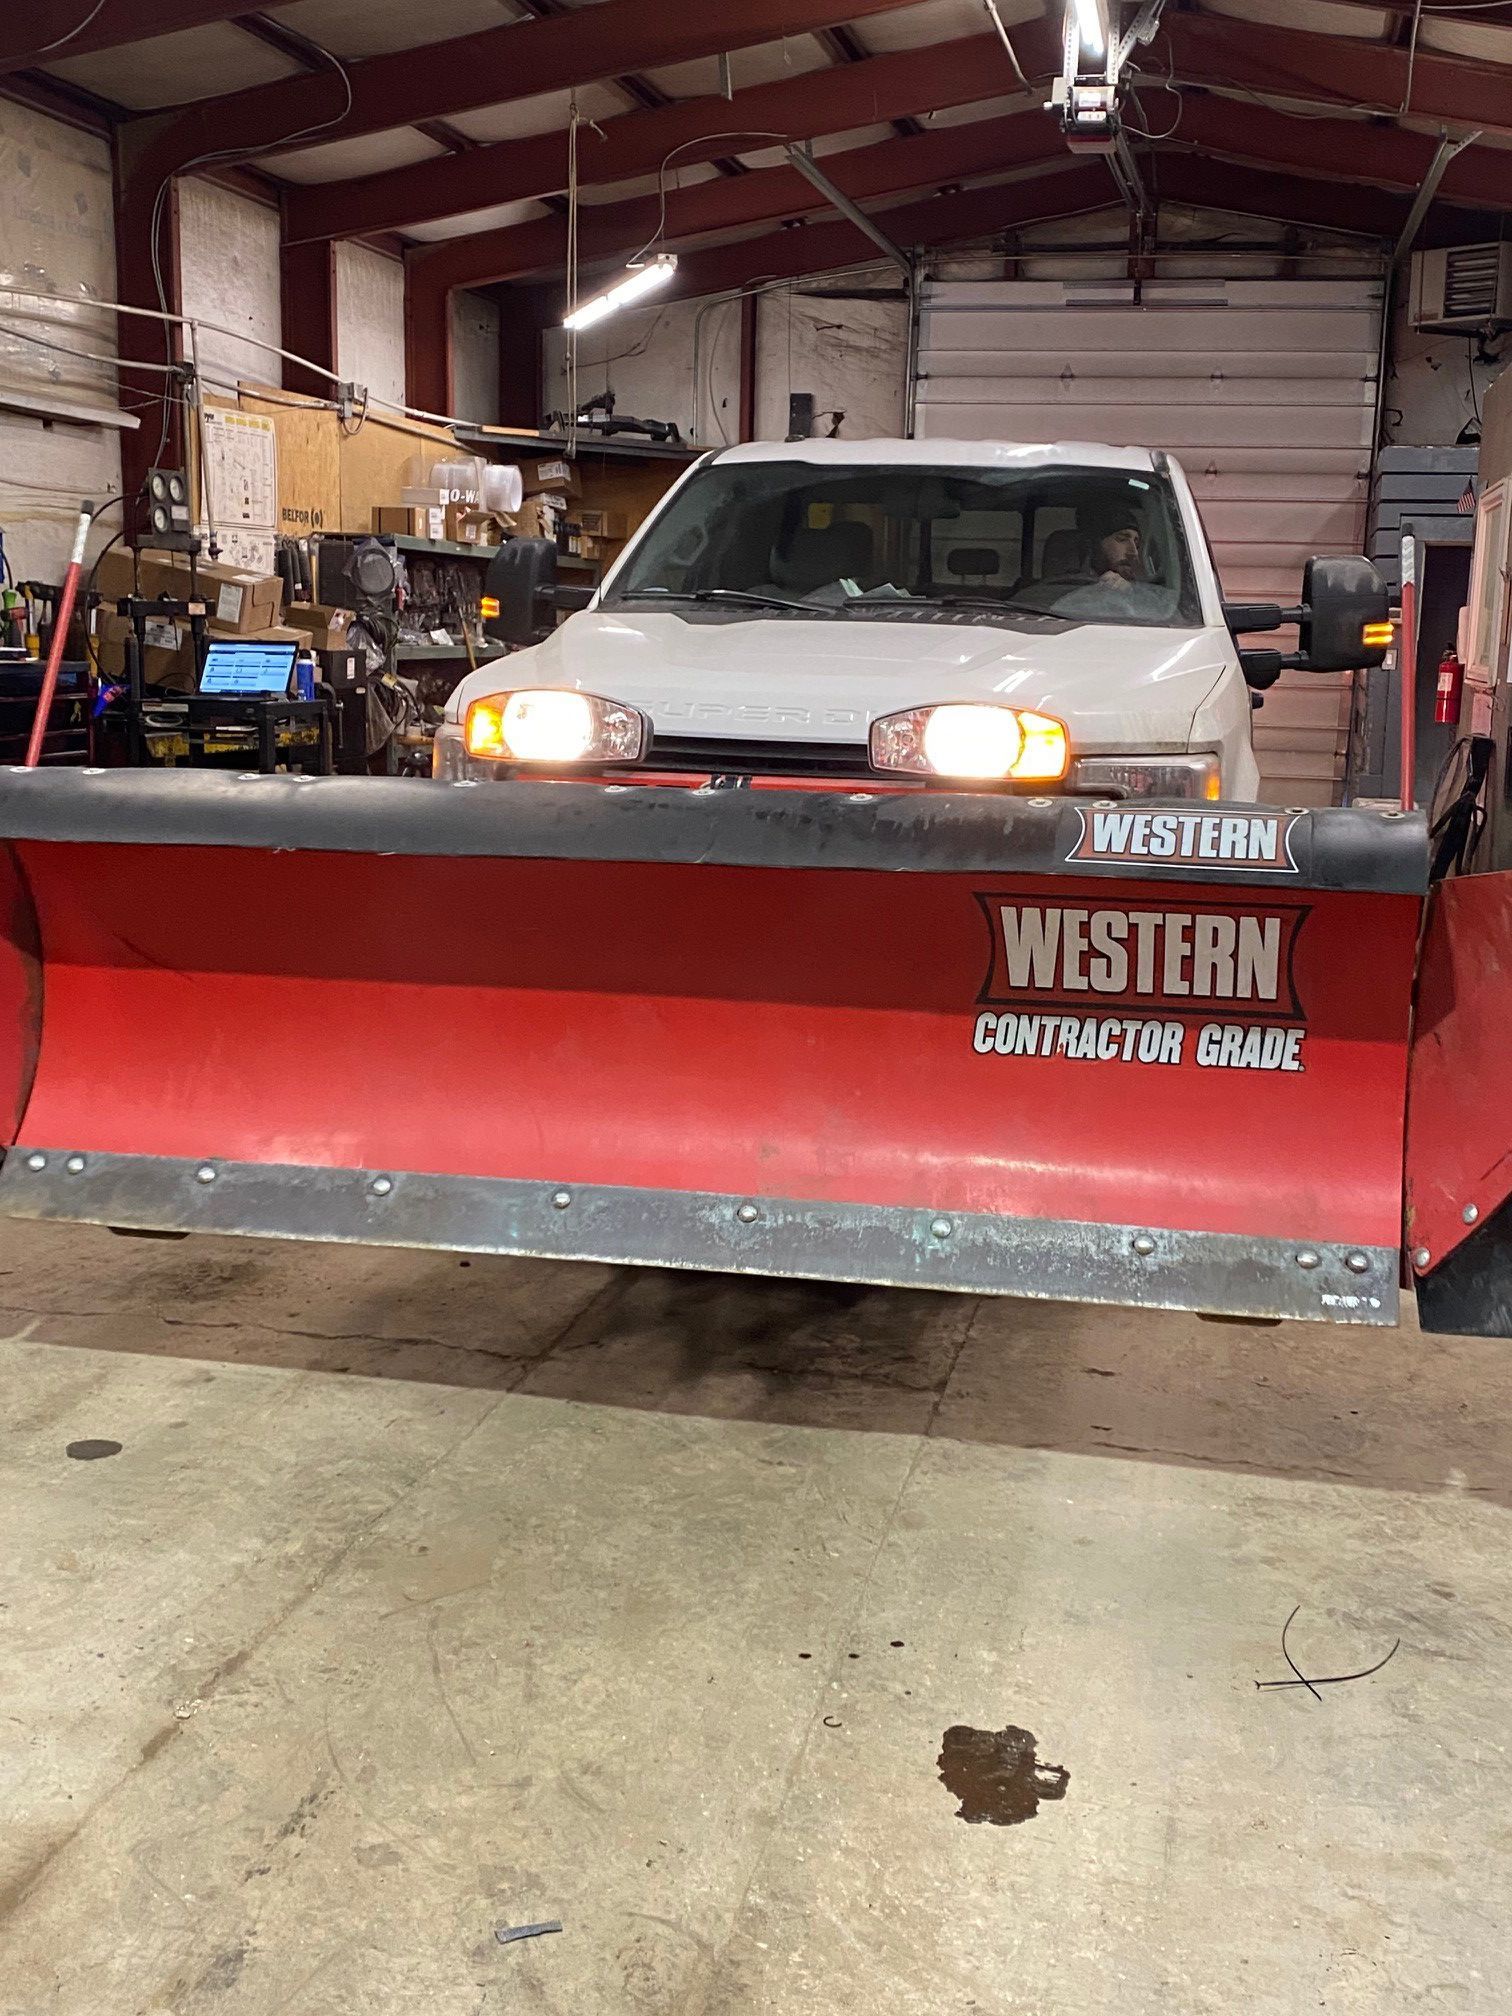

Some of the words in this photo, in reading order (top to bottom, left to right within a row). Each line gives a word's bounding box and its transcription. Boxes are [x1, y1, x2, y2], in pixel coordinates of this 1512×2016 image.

[282, 508, 309, 523] BELFOR
[1093, 813, 1278, 860] WESTERN
[1000, 906, 1281, 1000] WESTERN
[973, 1012, 1184, 1064] CONTRACTOR
